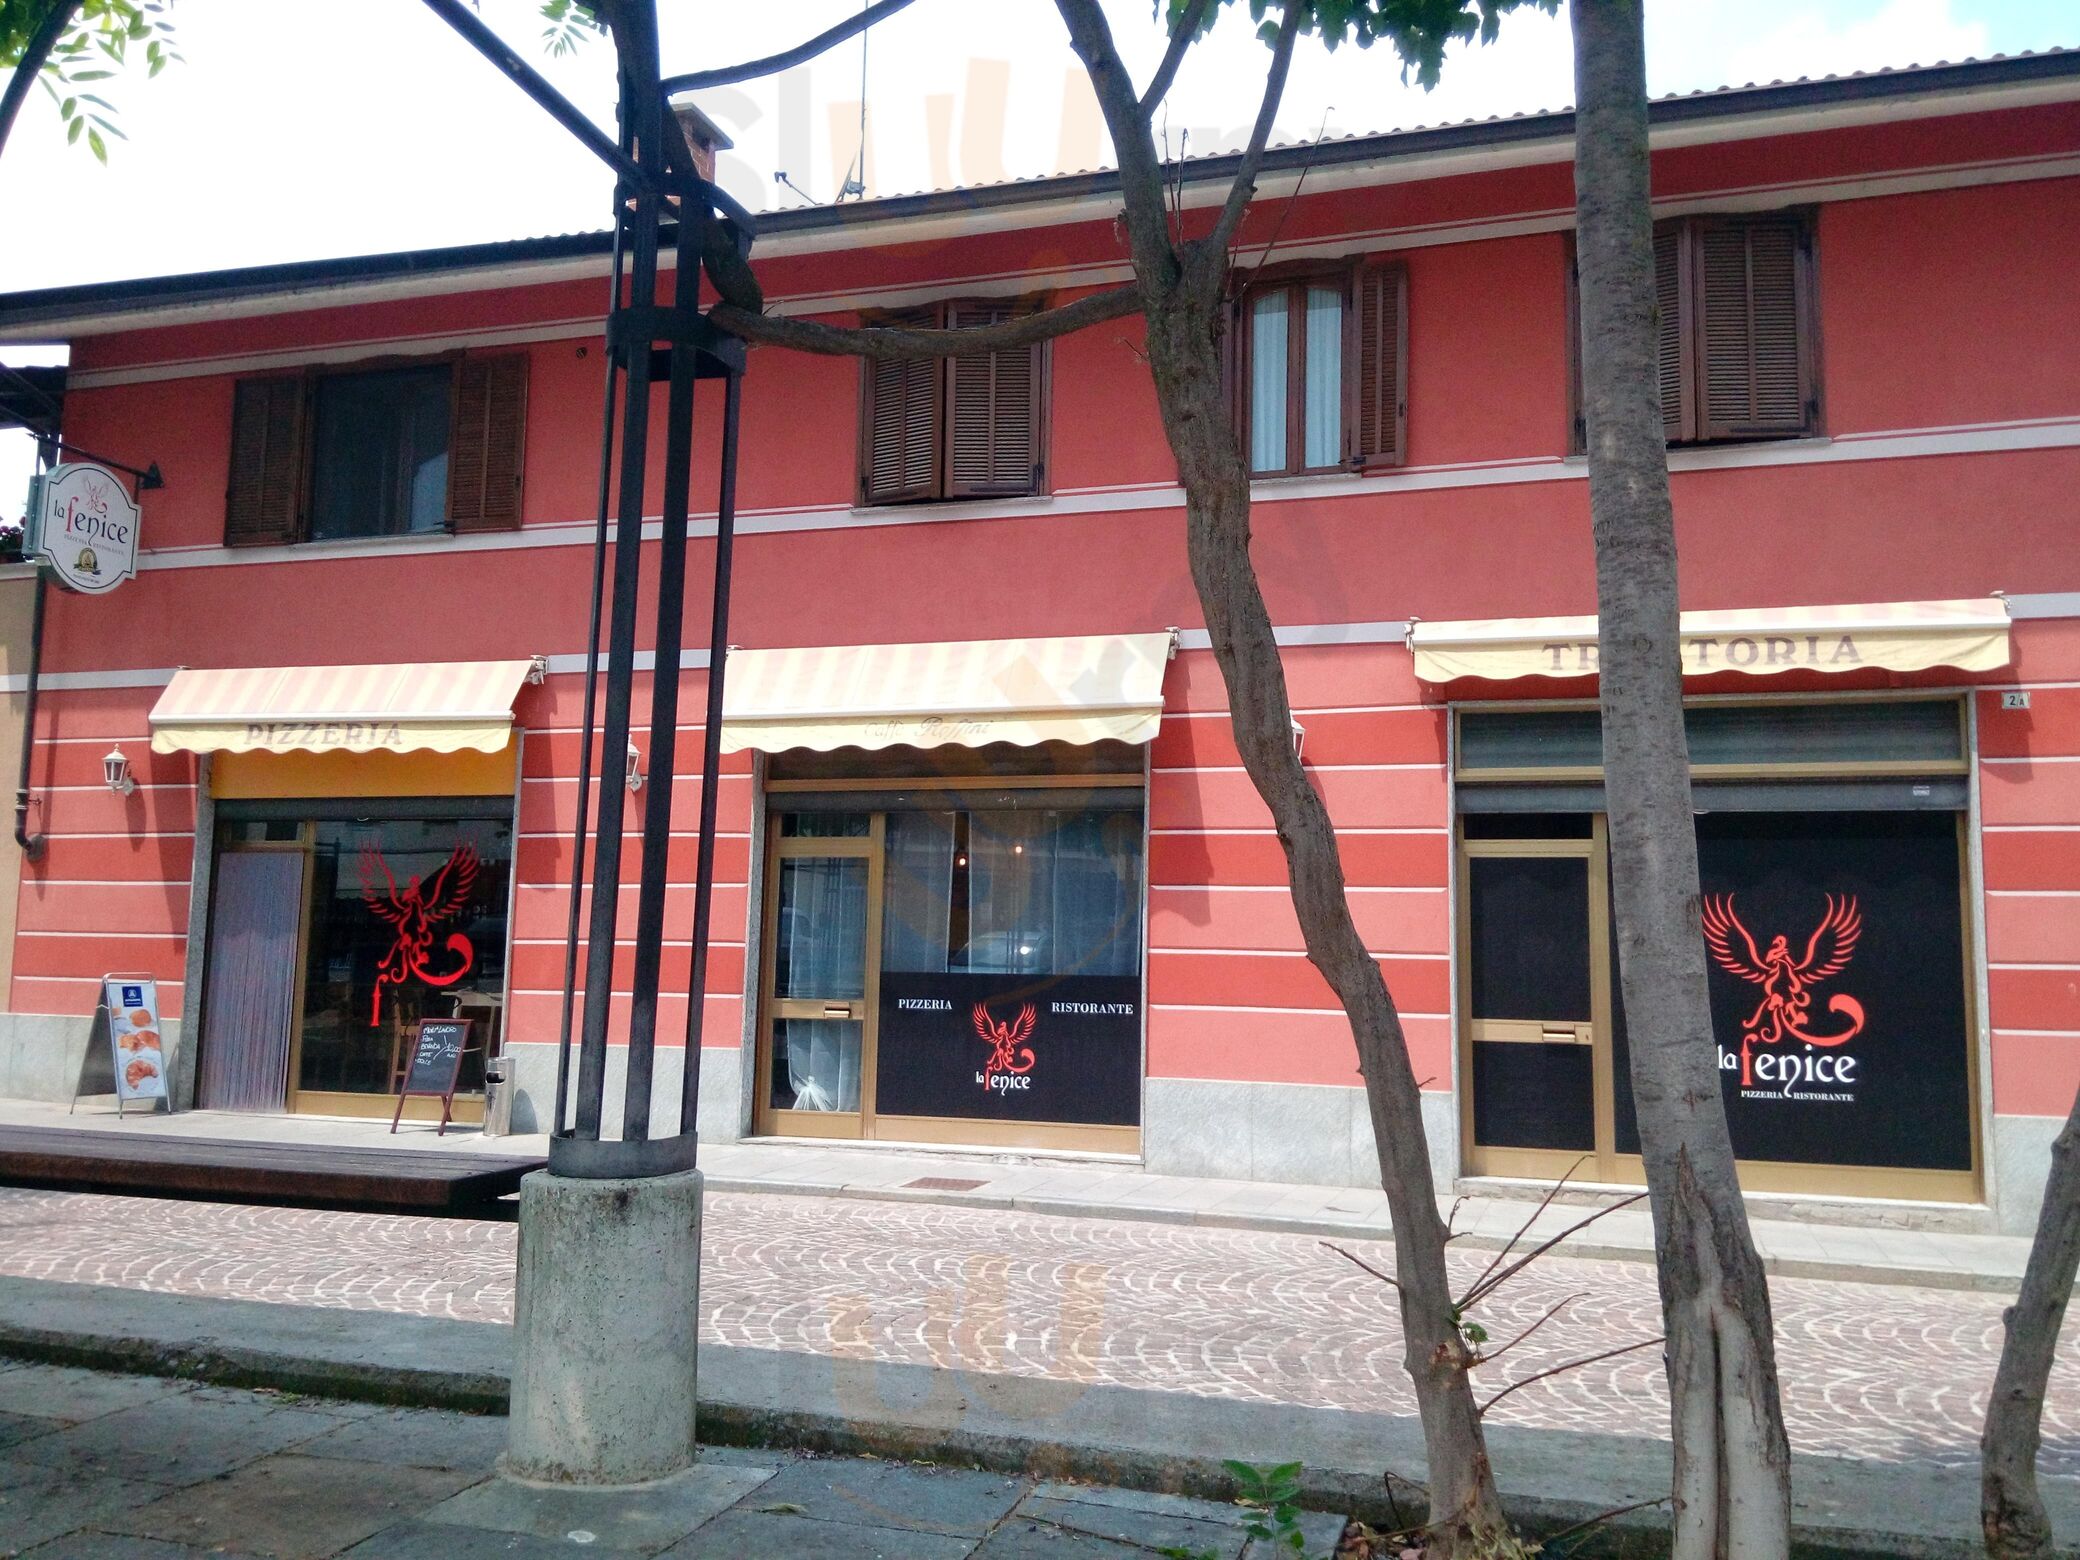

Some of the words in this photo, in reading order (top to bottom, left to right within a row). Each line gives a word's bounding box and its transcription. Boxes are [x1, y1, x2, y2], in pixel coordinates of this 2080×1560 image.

[54, 499, 65, 518] la
[65, 496, 128, 546] fenice
[1542, 635, 1863, 670] TRTORIA
[243, 724, 402, 746] PIZZERIA
[898, 998, 952, 1010] PIZZERIA
[1051, 1002, 1133, 1015] RISTORANTE
[1717, 1043, 1739, 1070] la
[1740, 1033, 1857, 1098] fenice
[975, 1071, 984, 1083] la
[983, 1065, 1030, 1096] fenice
[1741, 1089, 1783, 1099] PIZZERIA
[1793, 1092, 1854, 1102] RISTORANTE
